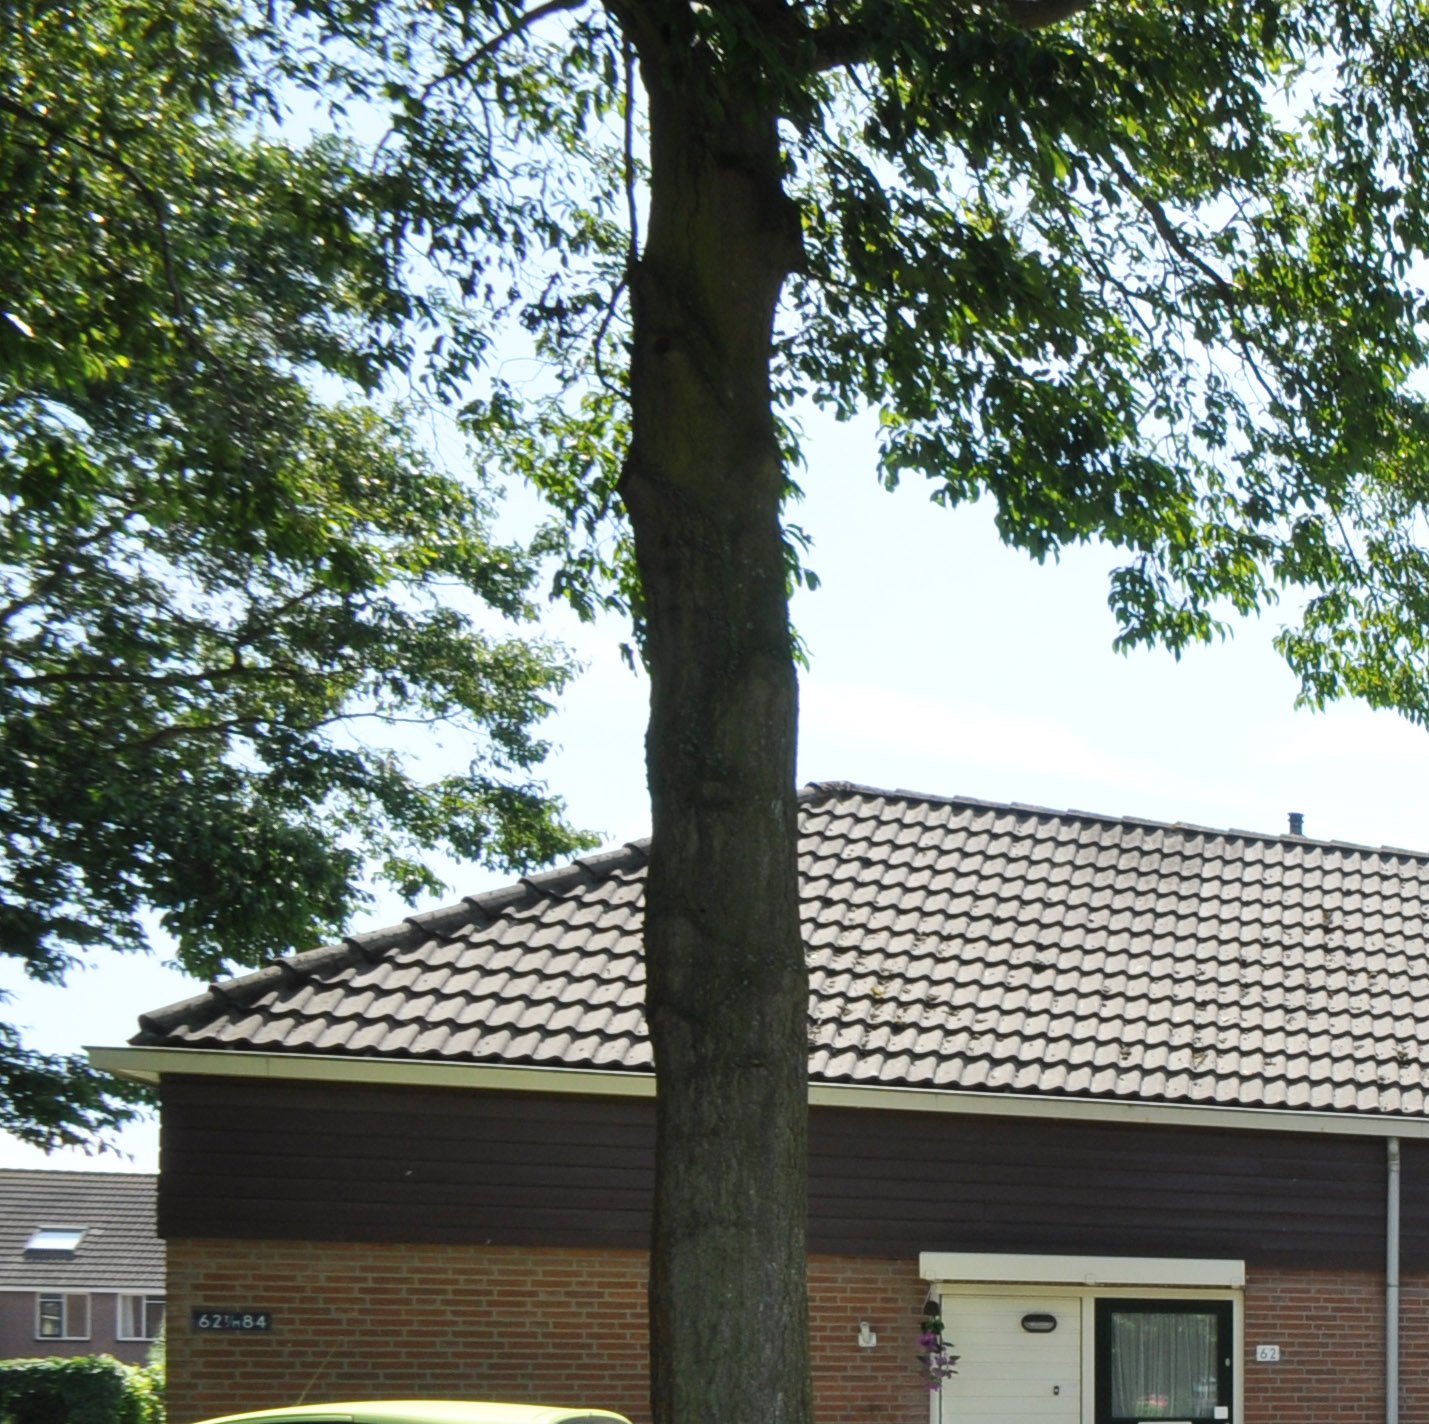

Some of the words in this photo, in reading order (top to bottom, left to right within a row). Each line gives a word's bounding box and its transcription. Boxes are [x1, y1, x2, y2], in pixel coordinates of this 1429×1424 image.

[199, 1314, 222, 1328] 62
[242, 1314, 267, 1329] 84
[1260, 1347, 1276, 1360] 62
